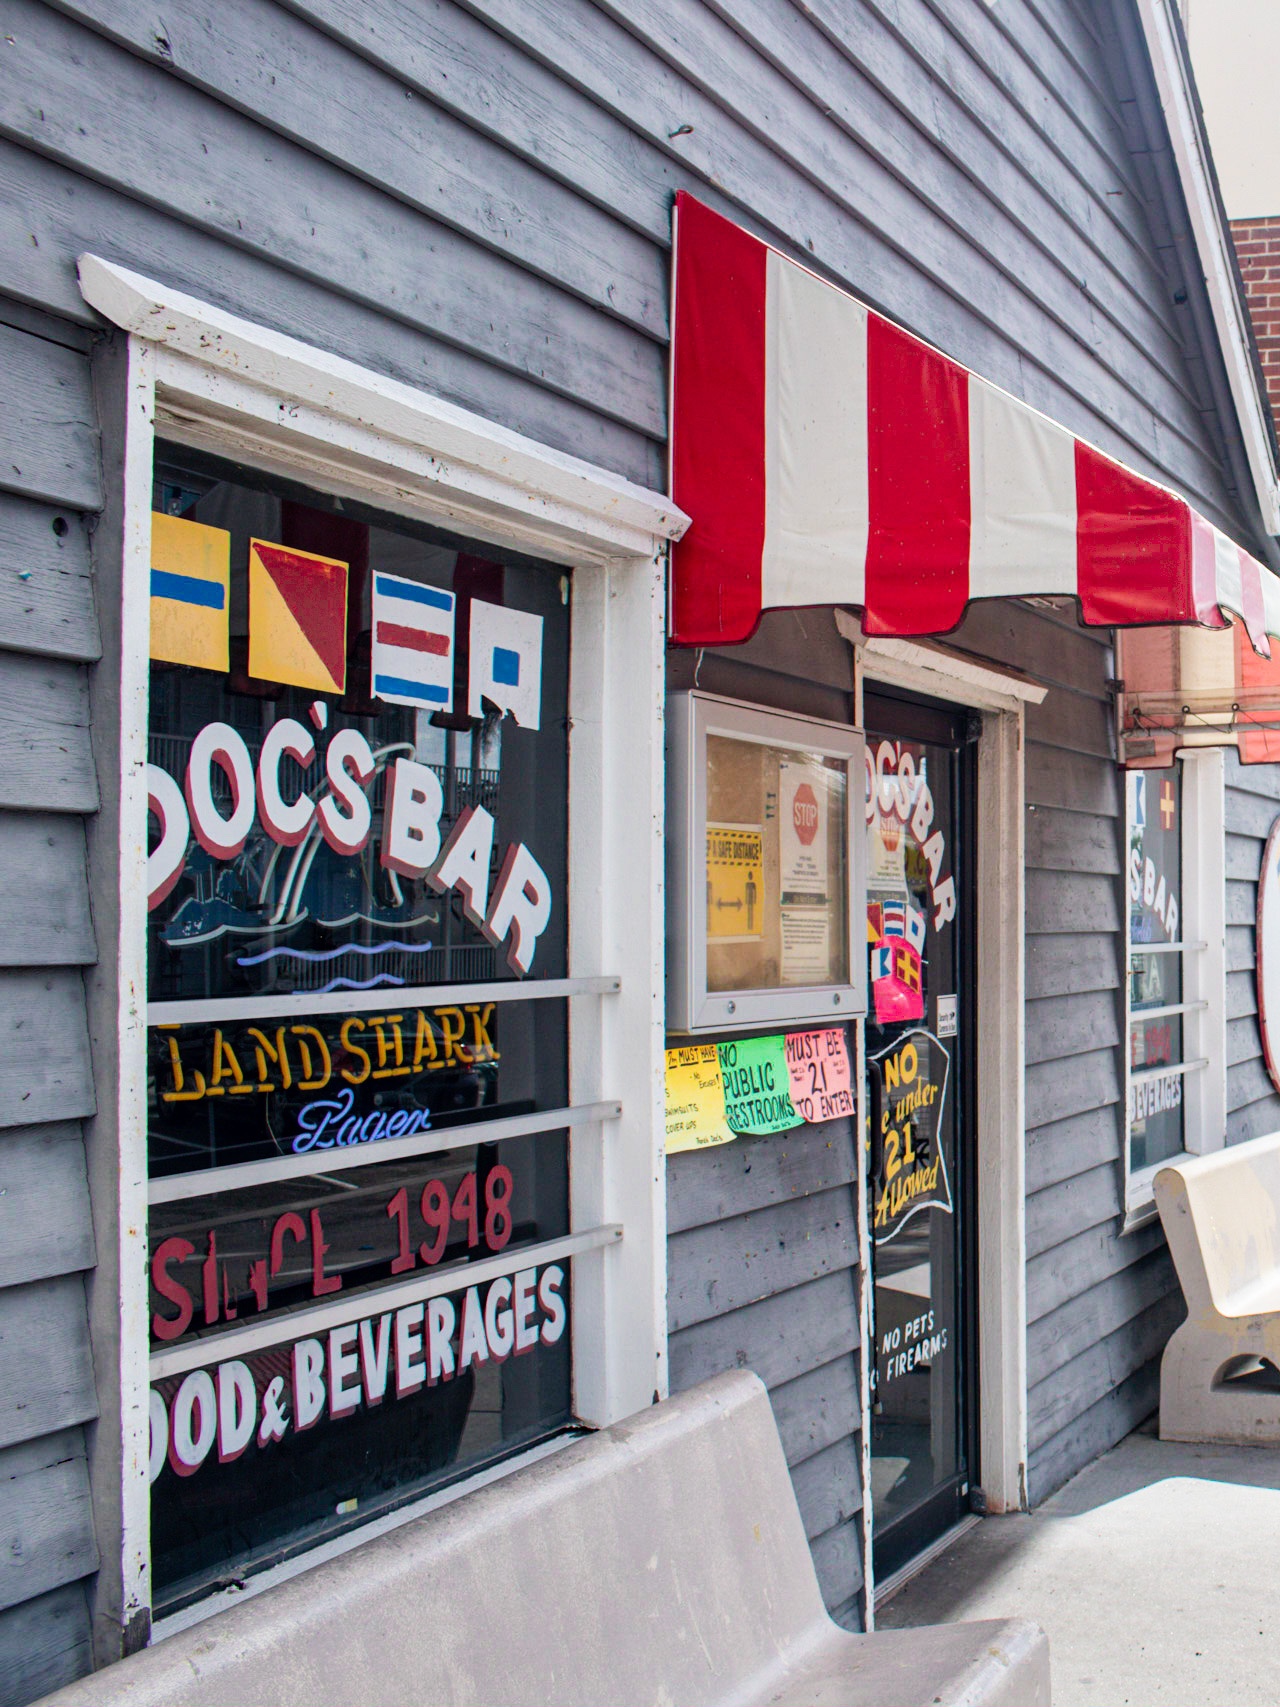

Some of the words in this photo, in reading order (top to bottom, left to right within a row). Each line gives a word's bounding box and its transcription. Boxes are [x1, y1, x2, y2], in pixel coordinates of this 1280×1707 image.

[794, 801, 817, 827] STOP
[381, 757, 552, 977] BAR
[911, 783, 956, 932] BAR
[1143, 856, 1179, 943] BAR
[678, 1048, 700, 1063] MUST
[700, 1046, 716, 1059] HAVE
[718, 1044, 737, 1068] NO
[786, 1034, 820, 1062] MUST
[826, 1031, 841, 1057] BE
[884, 1043, 918, 1093] NO
[722, 1062, 775, 1100] PUBLIC
[896, 1075, 938, 1122] under
[1131, 1074, 1182, 1123] BEVERAGES
[666, 1122, 685, 1135] COVER
[726, 1092, 796, 1130] RESTROOMS
[796, 1097, 814, 1120] TO
[820, 1090, 852, 1118] ENTER
[884, 1121, 916, 1182] 21
[386, 1165, 514, 1275] 1948
[292, 1265, 566, 1433] BEVERAGES
[882, 1327, 901, 1355] NO
[904, 1309, 935, 1344] PETS
[886, 1328, 948, 1382] FIREARMS
